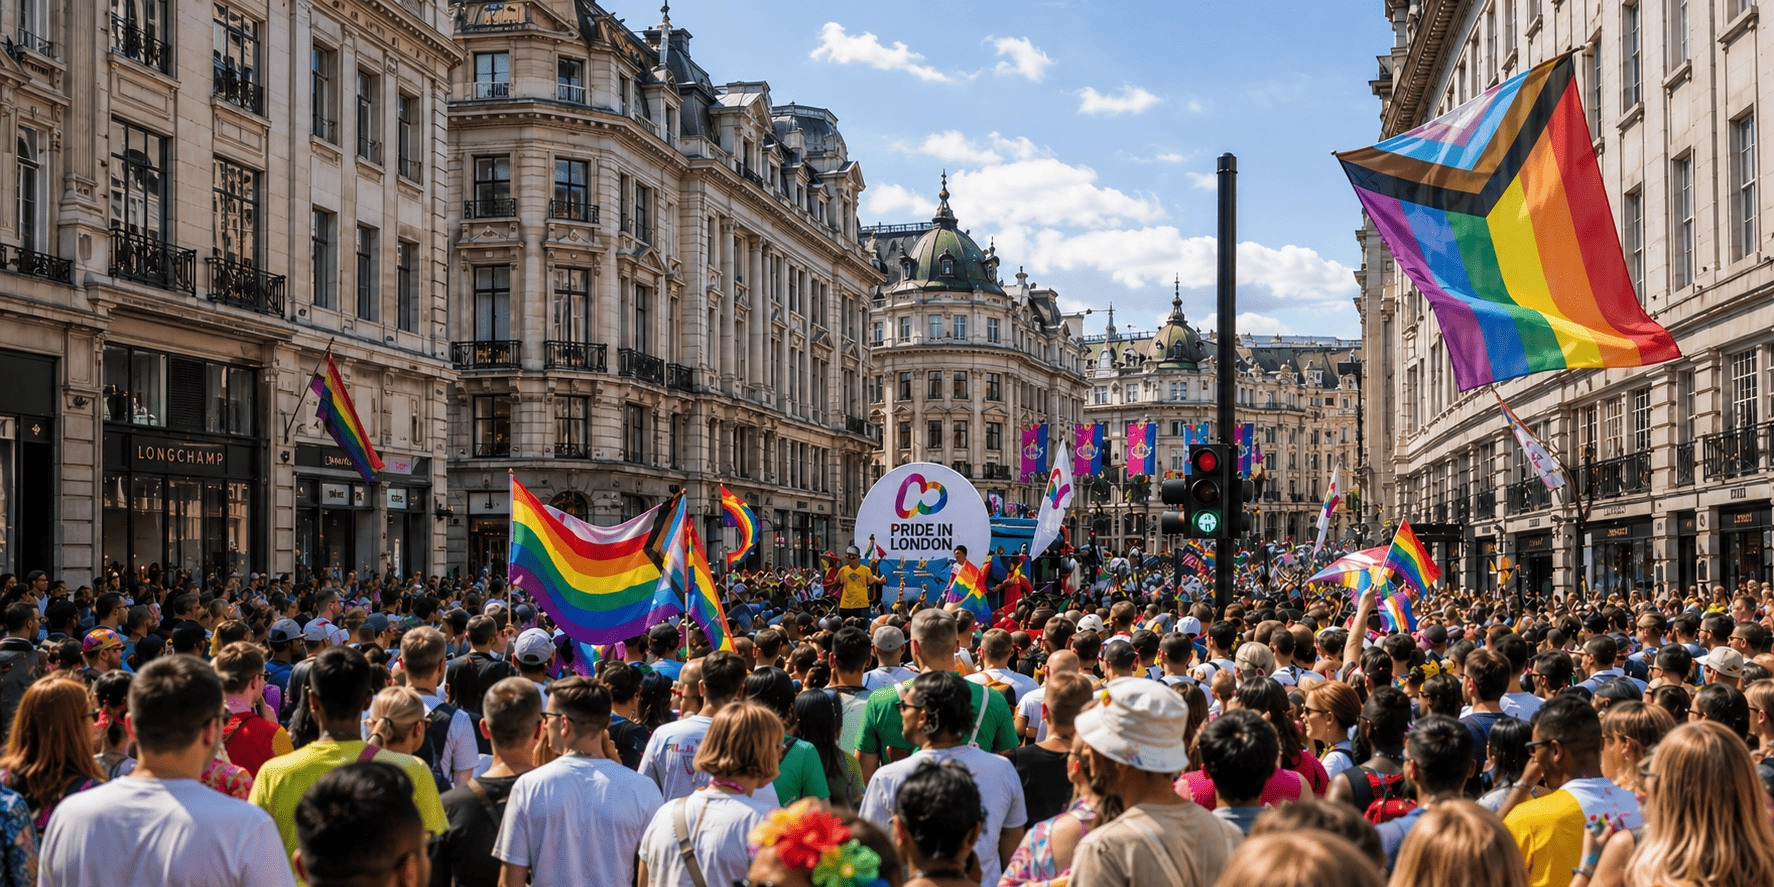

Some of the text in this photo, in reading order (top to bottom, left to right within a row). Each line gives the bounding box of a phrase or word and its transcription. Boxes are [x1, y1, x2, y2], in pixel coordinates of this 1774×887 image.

[138, 445, 224, 465] LONGCHAMP
[891, 523, 953, 536] PRIDE IN
[890, 537, 953, 550] LONDON
